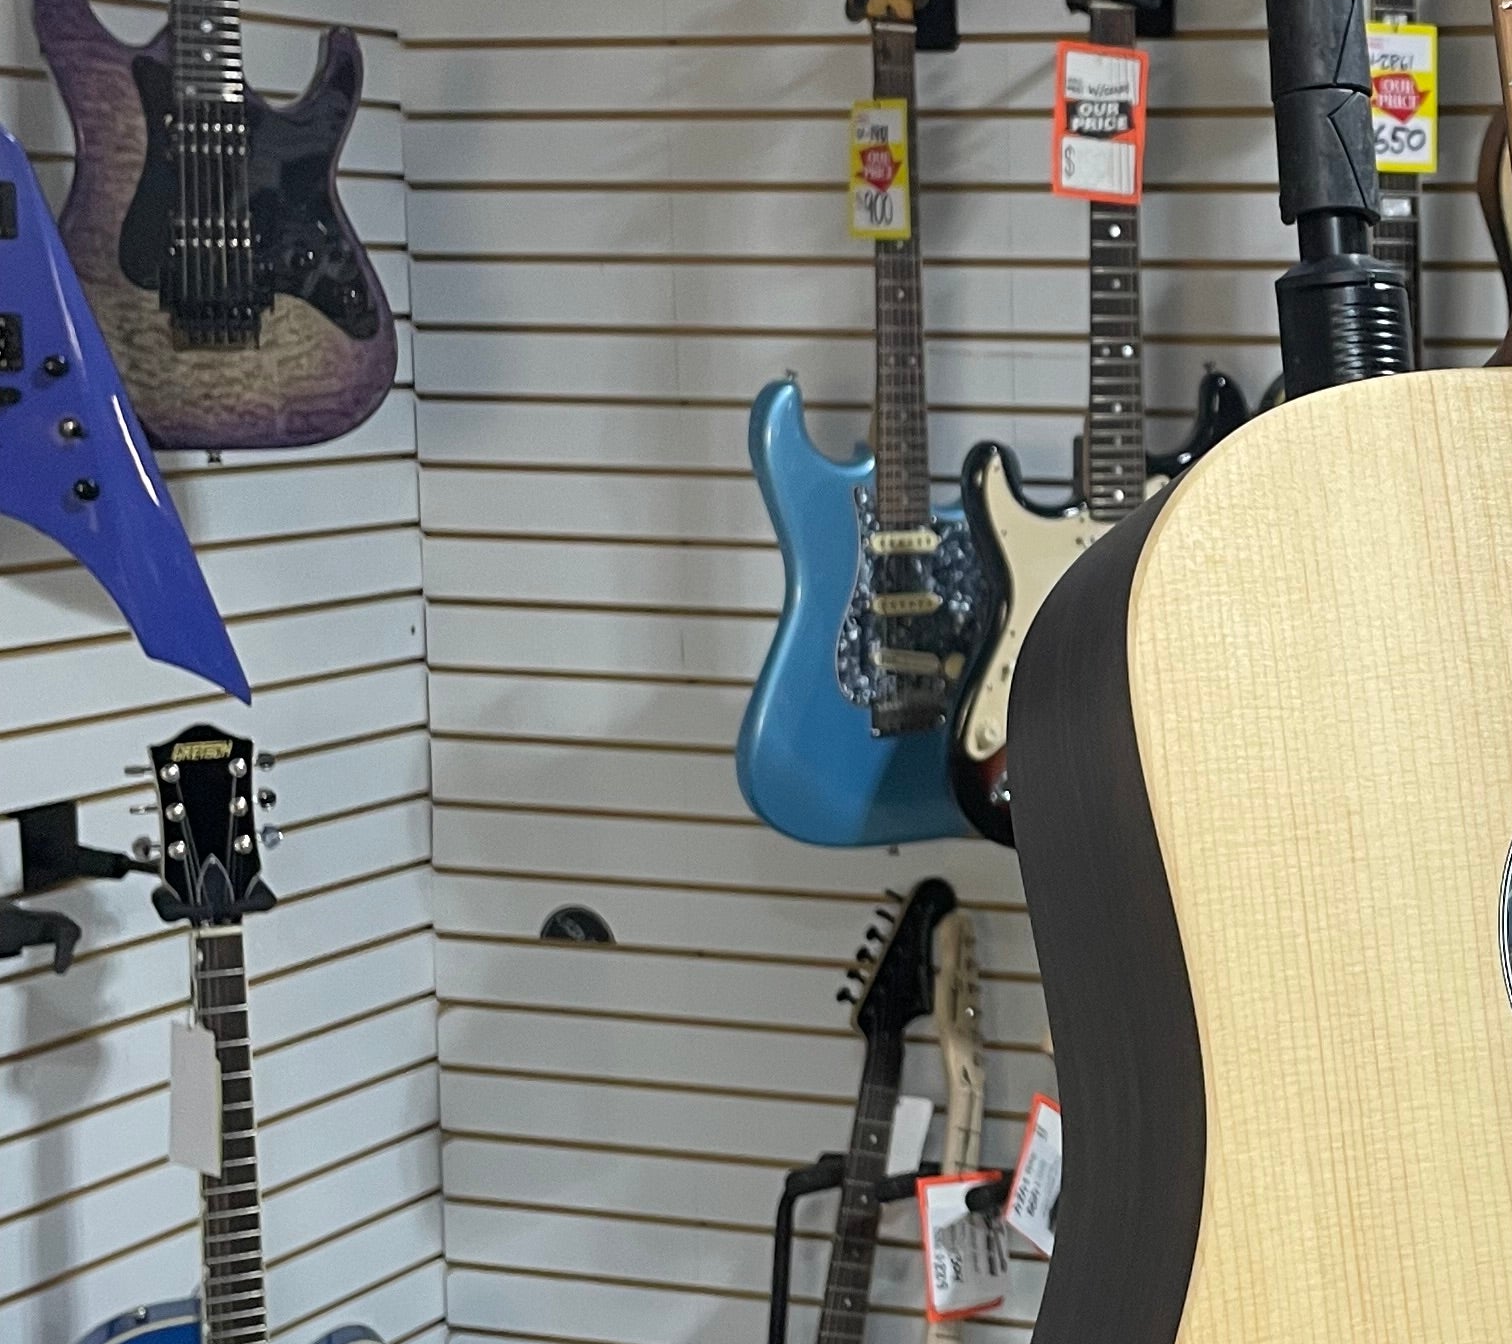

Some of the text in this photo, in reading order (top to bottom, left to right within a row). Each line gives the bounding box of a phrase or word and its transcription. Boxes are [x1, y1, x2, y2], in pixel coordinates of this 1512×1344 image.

[1383, 77, 1413, 94] OUR
[1377, 93, 1417, 108] PRICE
[1077, 102, 1120, 117] OUR
[1071, 115, 1128, 133] PRICE
